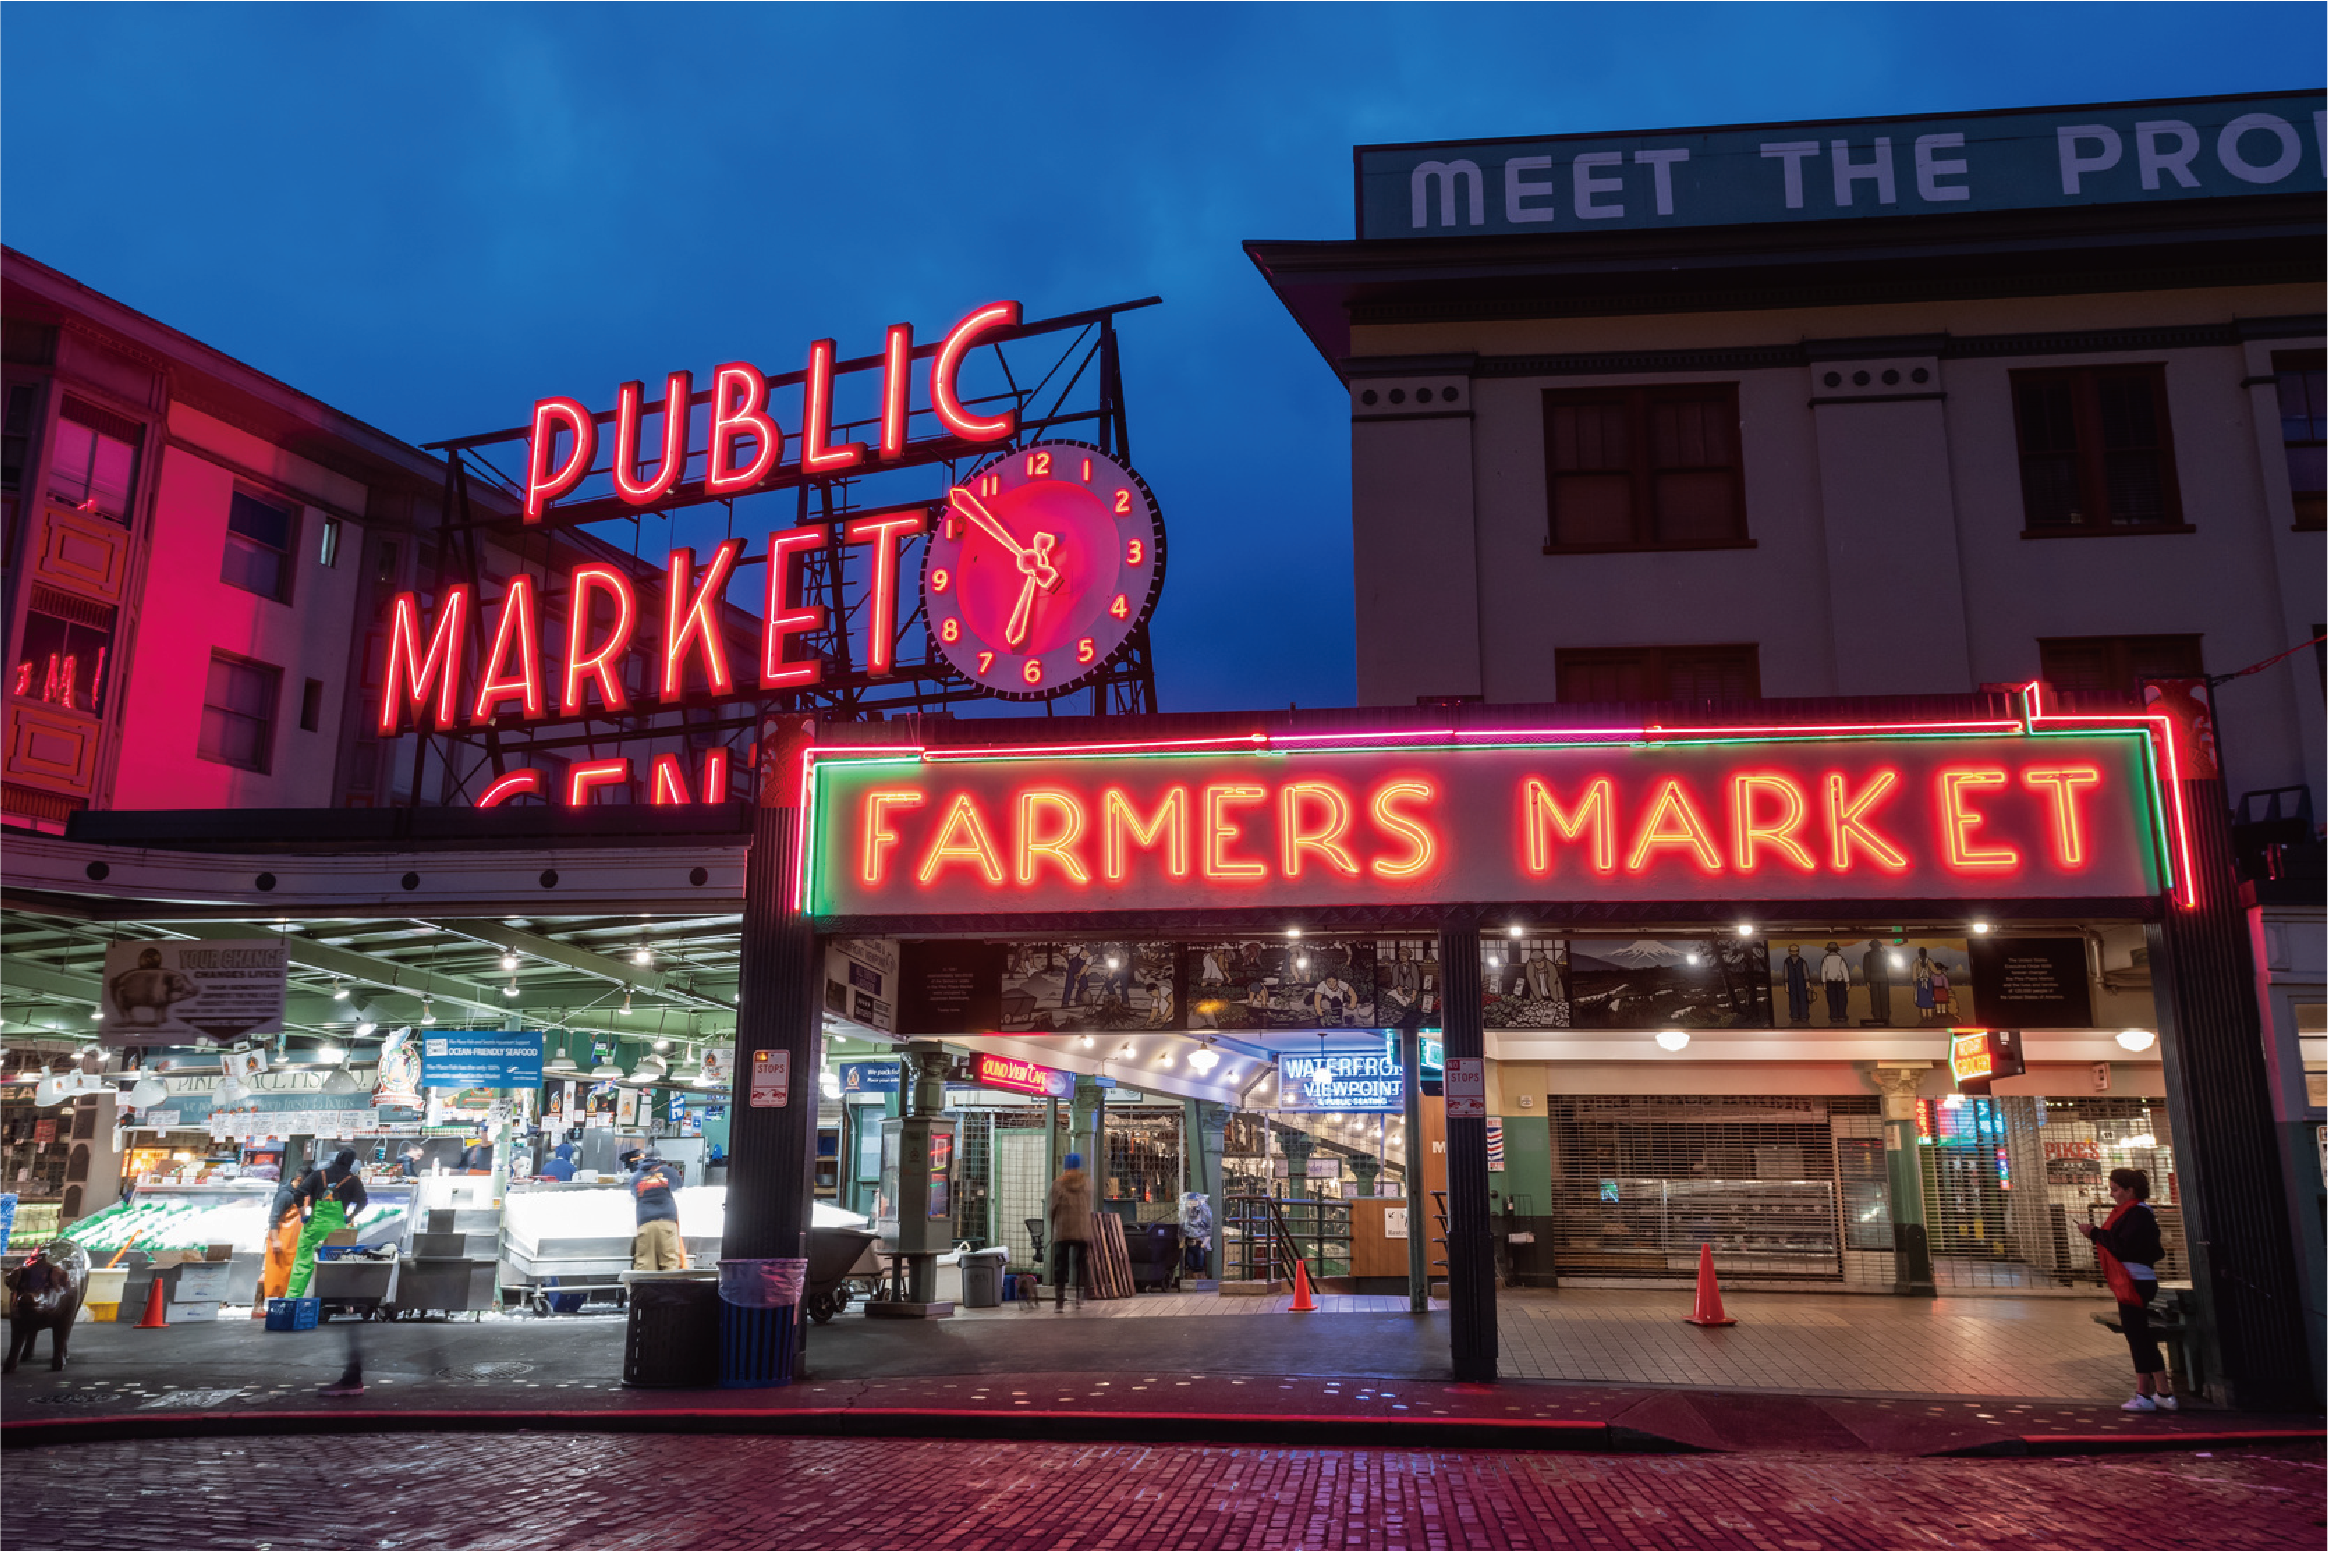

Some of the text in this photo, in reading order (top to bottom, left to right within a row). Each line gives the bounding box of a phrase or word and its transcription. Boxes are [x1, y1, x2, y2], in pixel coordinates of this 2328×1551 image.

[1411, 110, 2328, 229] MEET THE PRO
[522, 300, 1023, 525] PUBLIC
[1026, 452, 1050, 476] 12
[1082, 459, 1091, 481] 1
[981, 474, 999, 497] 11
[1114, 489, 1131, 514] 2
[1126, 539, 1143, 565] 3
[932, 569, 949, 592] 9
[1109, 593, 1128, 619] 4
[378, 508, 927, 737] MARKET
[942, 619, 958, 642] 8
[1077, 638, 1095, 663] 5
[977, 652, 994, 674] 7
[1023, 659, 1041, 684] 6
[864, 771, 2098, 881] FARMERS MARKET
[179, 948, 285, 970] YOUR CHANGE
[505, 1047, 538, 1057] SEAFOOD
[757, 1063, 785, 1074] STOPS
[1451, 1073, 1480, 1083] STOPS
[1303, 1080, 1402, 1096] VIEWPOINT
[1432, 1141, 1446, 1153] M
